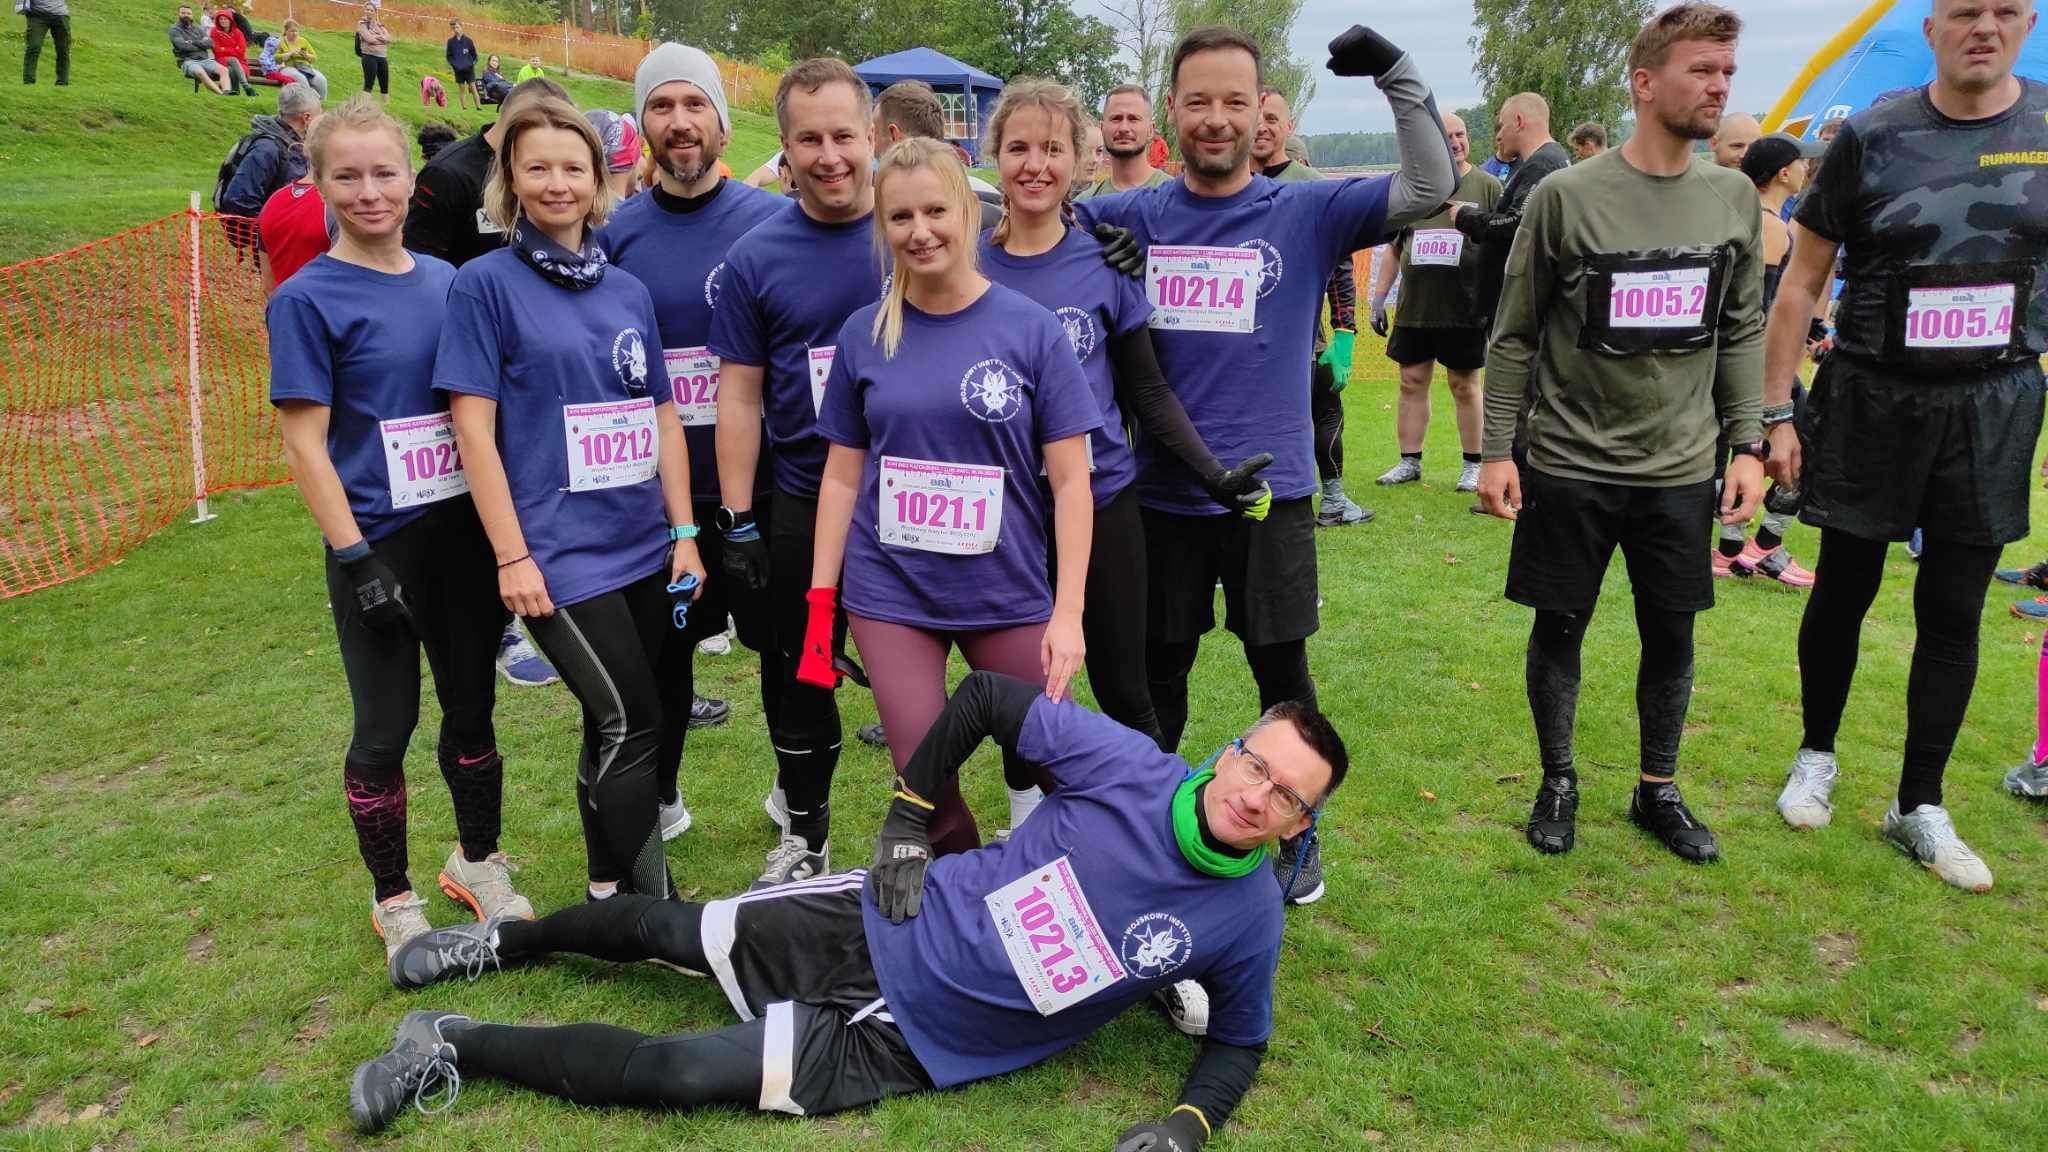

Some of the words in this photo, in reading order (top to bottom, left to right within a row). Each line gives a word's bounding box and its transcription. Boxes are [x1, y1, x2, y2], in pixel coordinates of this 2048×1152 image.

[1416, 241, 1457, 256] 1008.1
[1156, 275, 1244, 309] 1021.4
[1612, 285, 1705, 317] 1005.2
[1907, 305, 2011, 339] 1005.4
[577, 427, 652, 466] 1021.2
[894, 491, 986, 531] 1021.1
[1014, 886, 1088, 993] 1021.3
[1125, 912, 1169, 935] WOJSKOWY
